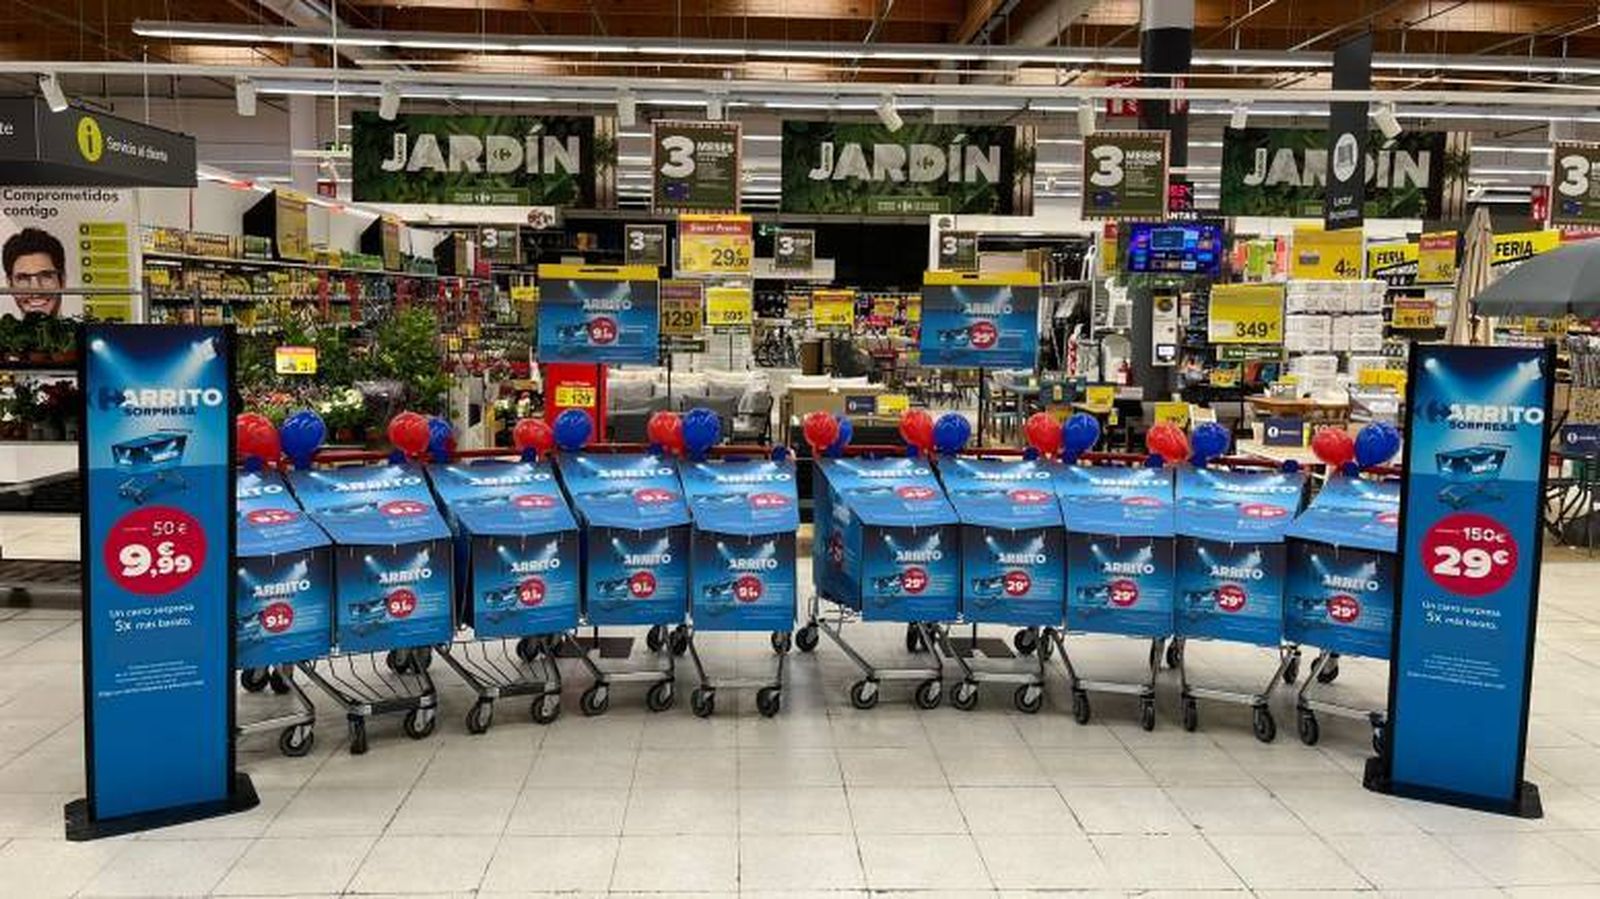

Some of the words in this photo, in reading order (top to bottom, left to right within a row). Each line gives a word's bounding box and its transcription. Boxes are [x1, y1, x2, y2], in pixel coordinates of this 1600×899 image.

[381, 124, 580, 173] JARDÍN
[661, 135, 695, 178] 3
[808, 134, 1001, 182] JARDÍN
[1090, 145, 1124, 186] 3
[1559, 155, 1590, 196] 3
[3, 189, 119, 202] Comprometidos
[3, 204, 58, 218] contigo
[482, 229, 497, 247] 3
[629, 231, 645, 250] 3
[779, 237, 794, 255] 3
[942, 236, 957, 254] 3
[1495, 240, 1533, 256] FERIA
[125, 406, 196, 416] SORPRESA
[1449, 421, 1517, 432] SORPRESA
[109, 609, 124, 619] Un
[126, 608, 151, 617] carro
[154, 604, 195, 618] sorpresa
[1422, 601, 1436, 610] Un
